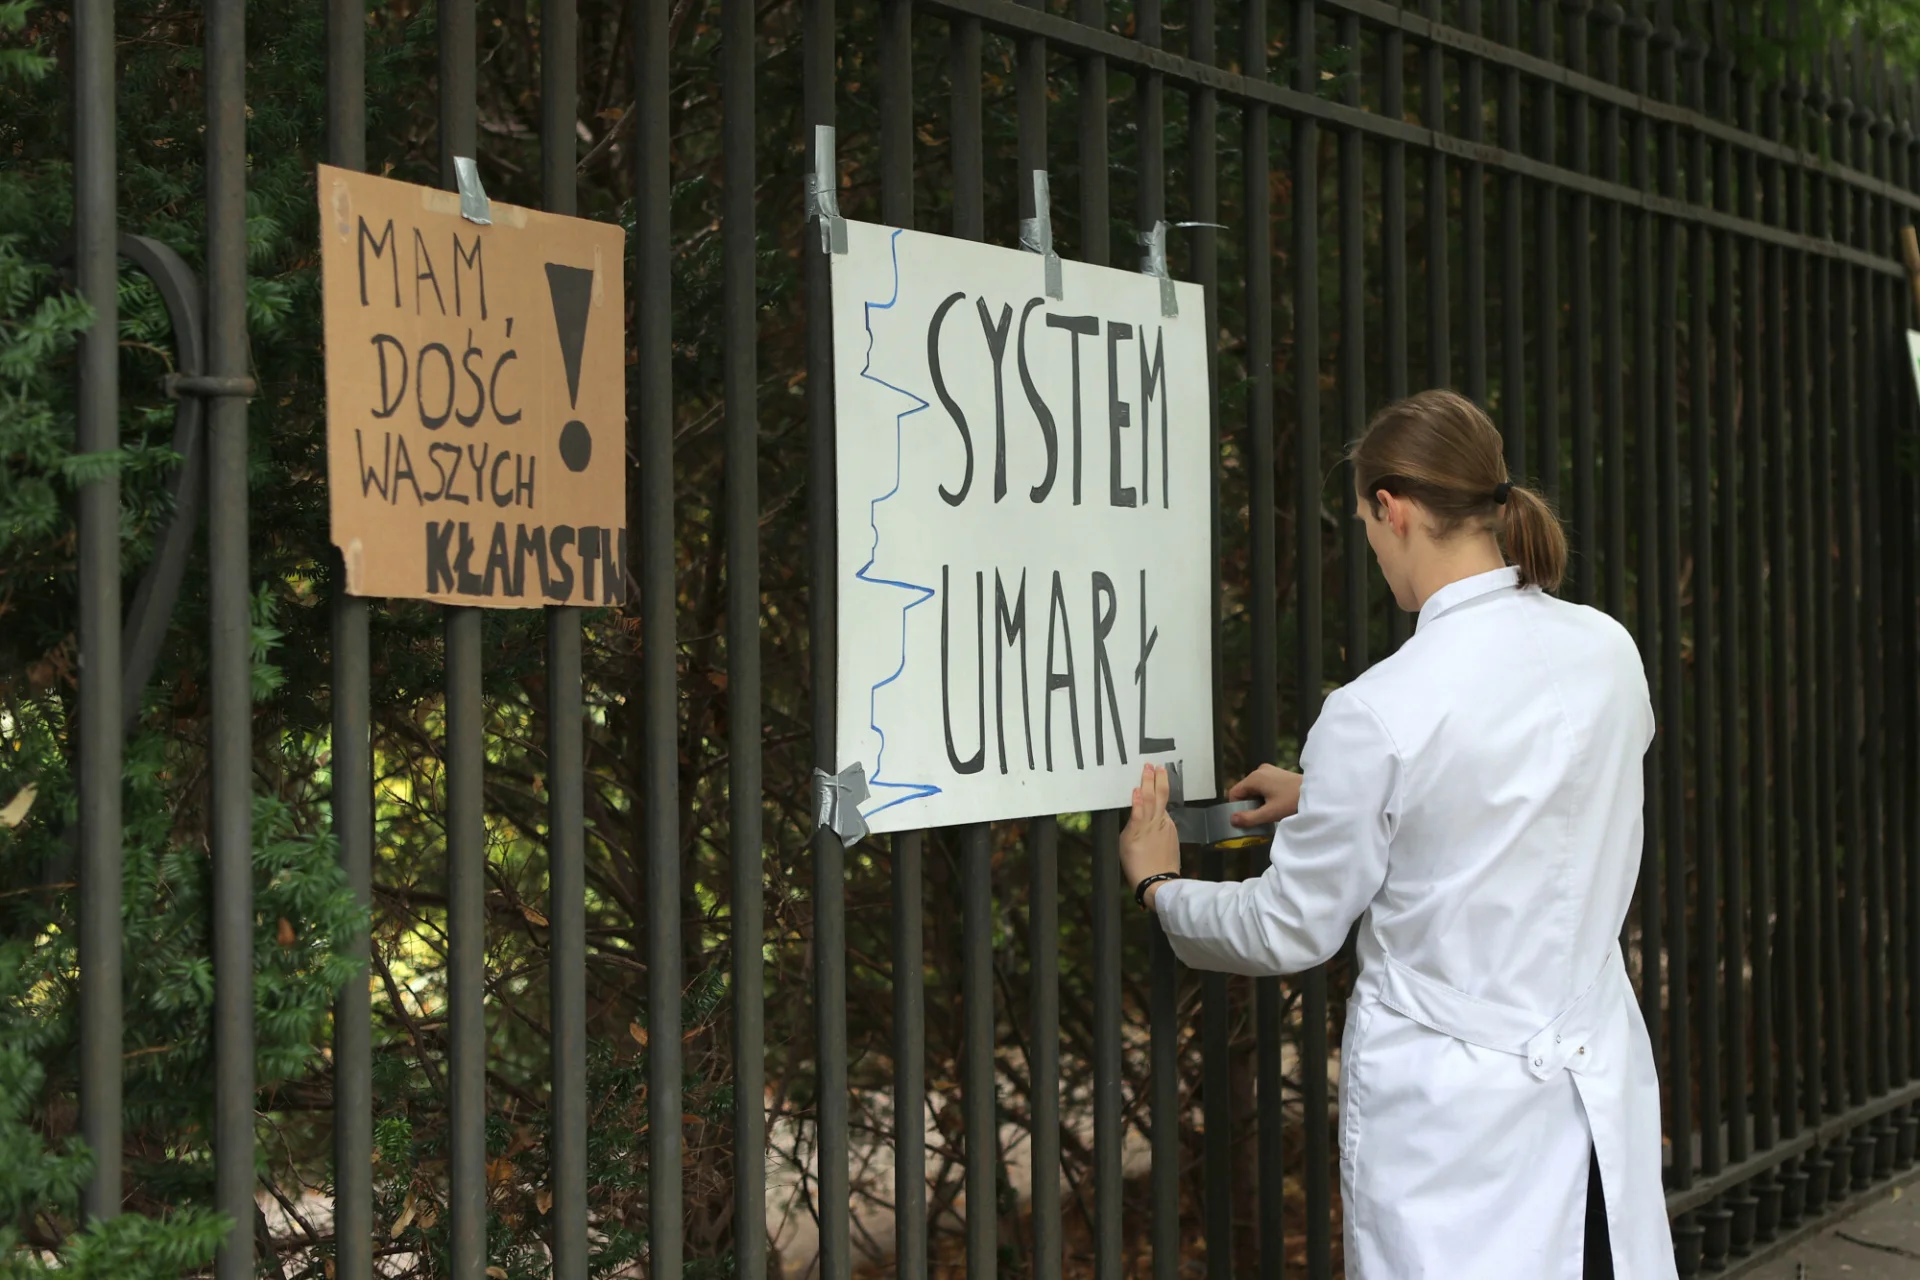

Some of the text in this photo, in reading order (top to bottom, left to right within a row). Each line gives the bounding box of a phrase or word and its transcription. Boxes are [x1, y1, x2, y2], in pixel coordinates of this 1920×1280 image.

[358, 215, 488, 320] MAM
[371, 317, 522, 430] DOŚĆ
[927, 291, 1168, 509] SYSTEM
[355, 428, 535, 508] WASZYCH
[941, 564, 1176, 775] UMARŁ
